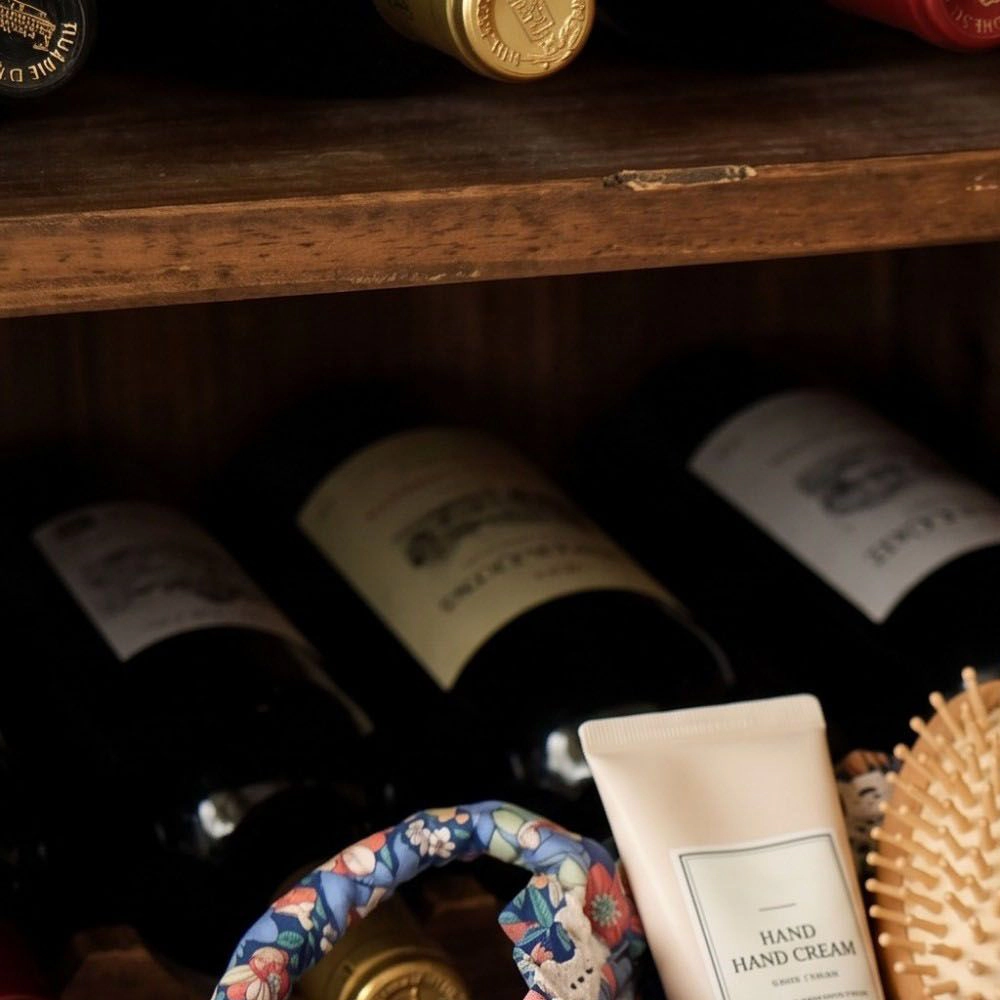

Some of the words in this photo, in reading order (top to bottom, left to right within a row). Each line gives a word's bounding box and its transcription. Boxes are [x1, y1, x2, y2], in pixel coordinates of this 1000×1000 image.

[761, 924, 816, 945] HAND
[732, 951, 788, 973] HAND
[793, 941, 856, 962] CREAM
